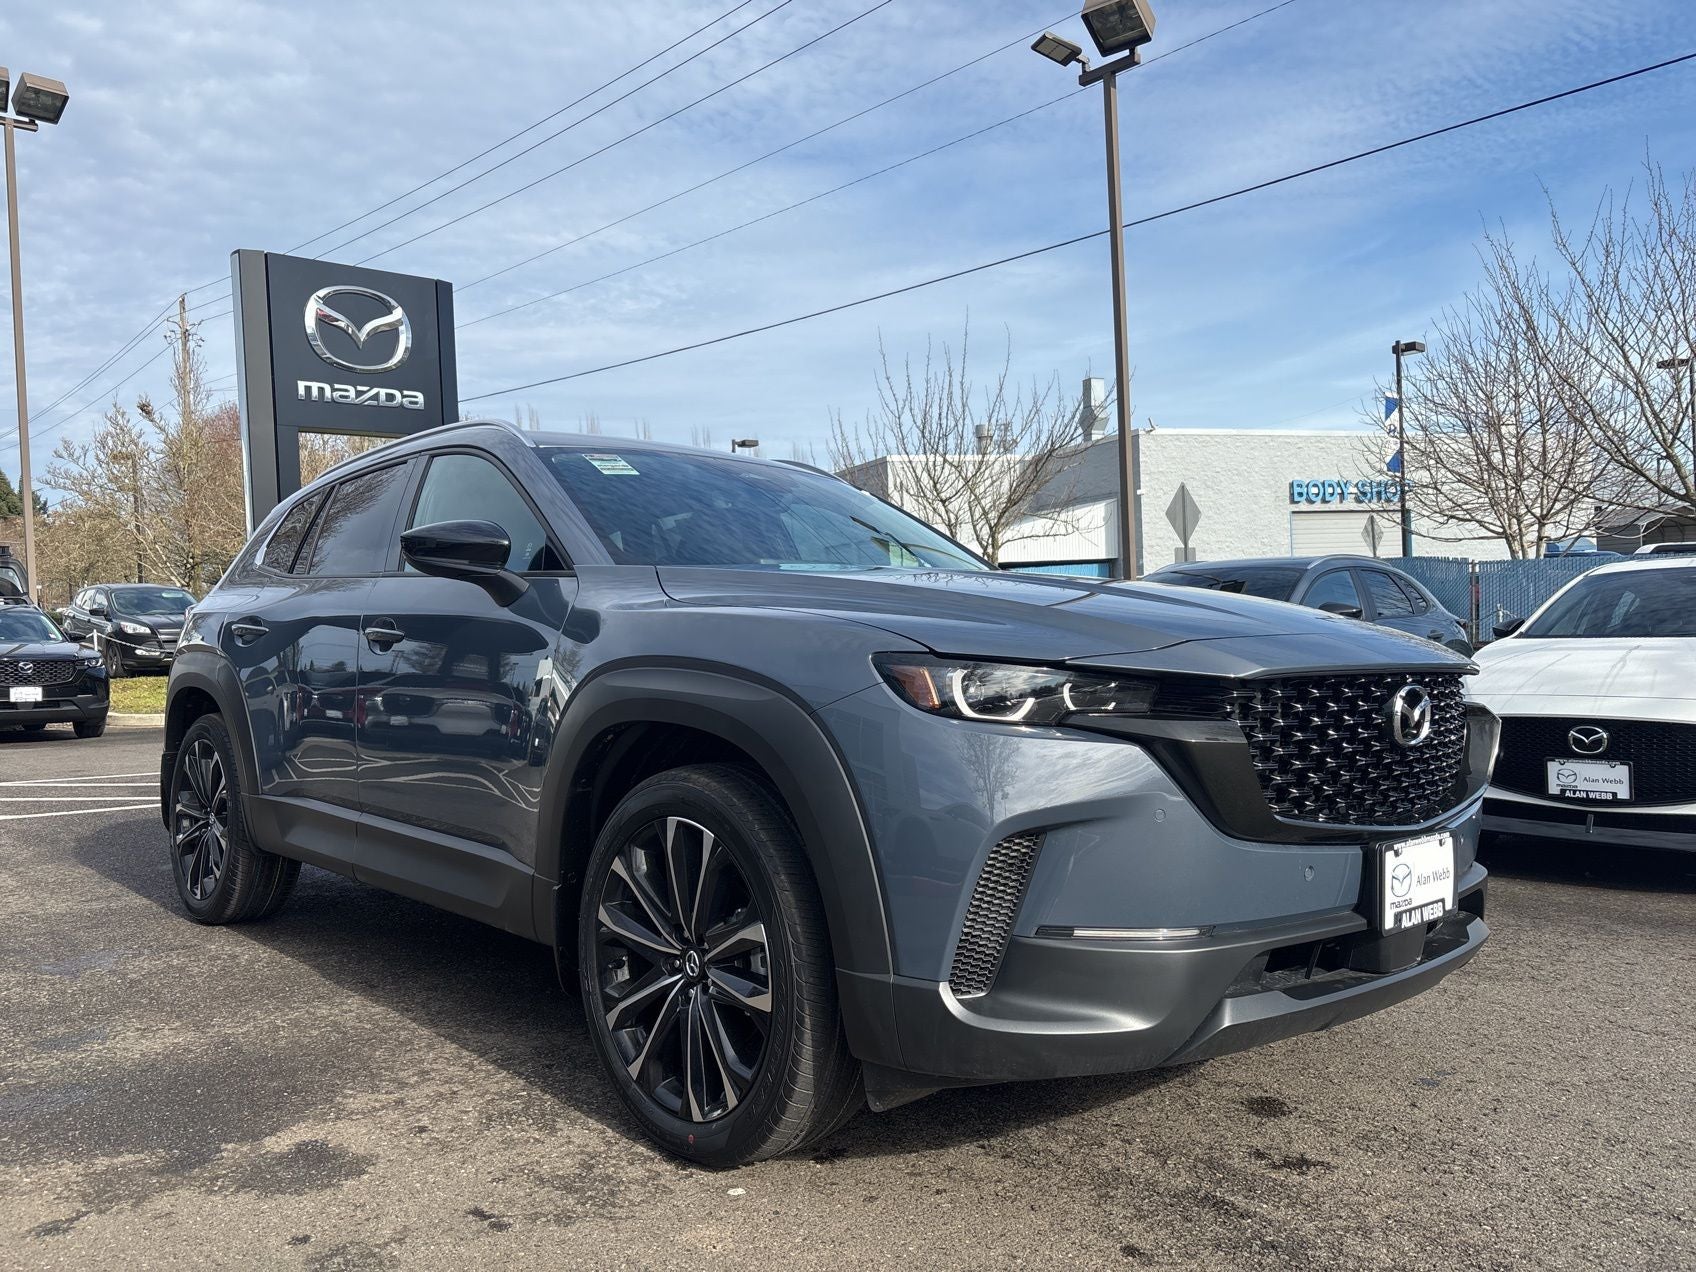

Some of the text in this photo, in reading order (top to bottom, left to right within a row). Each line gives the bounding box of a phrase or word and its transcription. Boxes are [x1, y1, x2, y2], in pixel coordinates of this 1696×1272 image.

[1290, 479, 1350, 503] BODY
[1583, 776, 1624, 785] Alan Webb
[1565, 790, 1613, 800] ALAN WEBB
[1416, 867, 1451, 887] Alan Webb
[1401, 901, 1444, 929] ALAN WEBB
